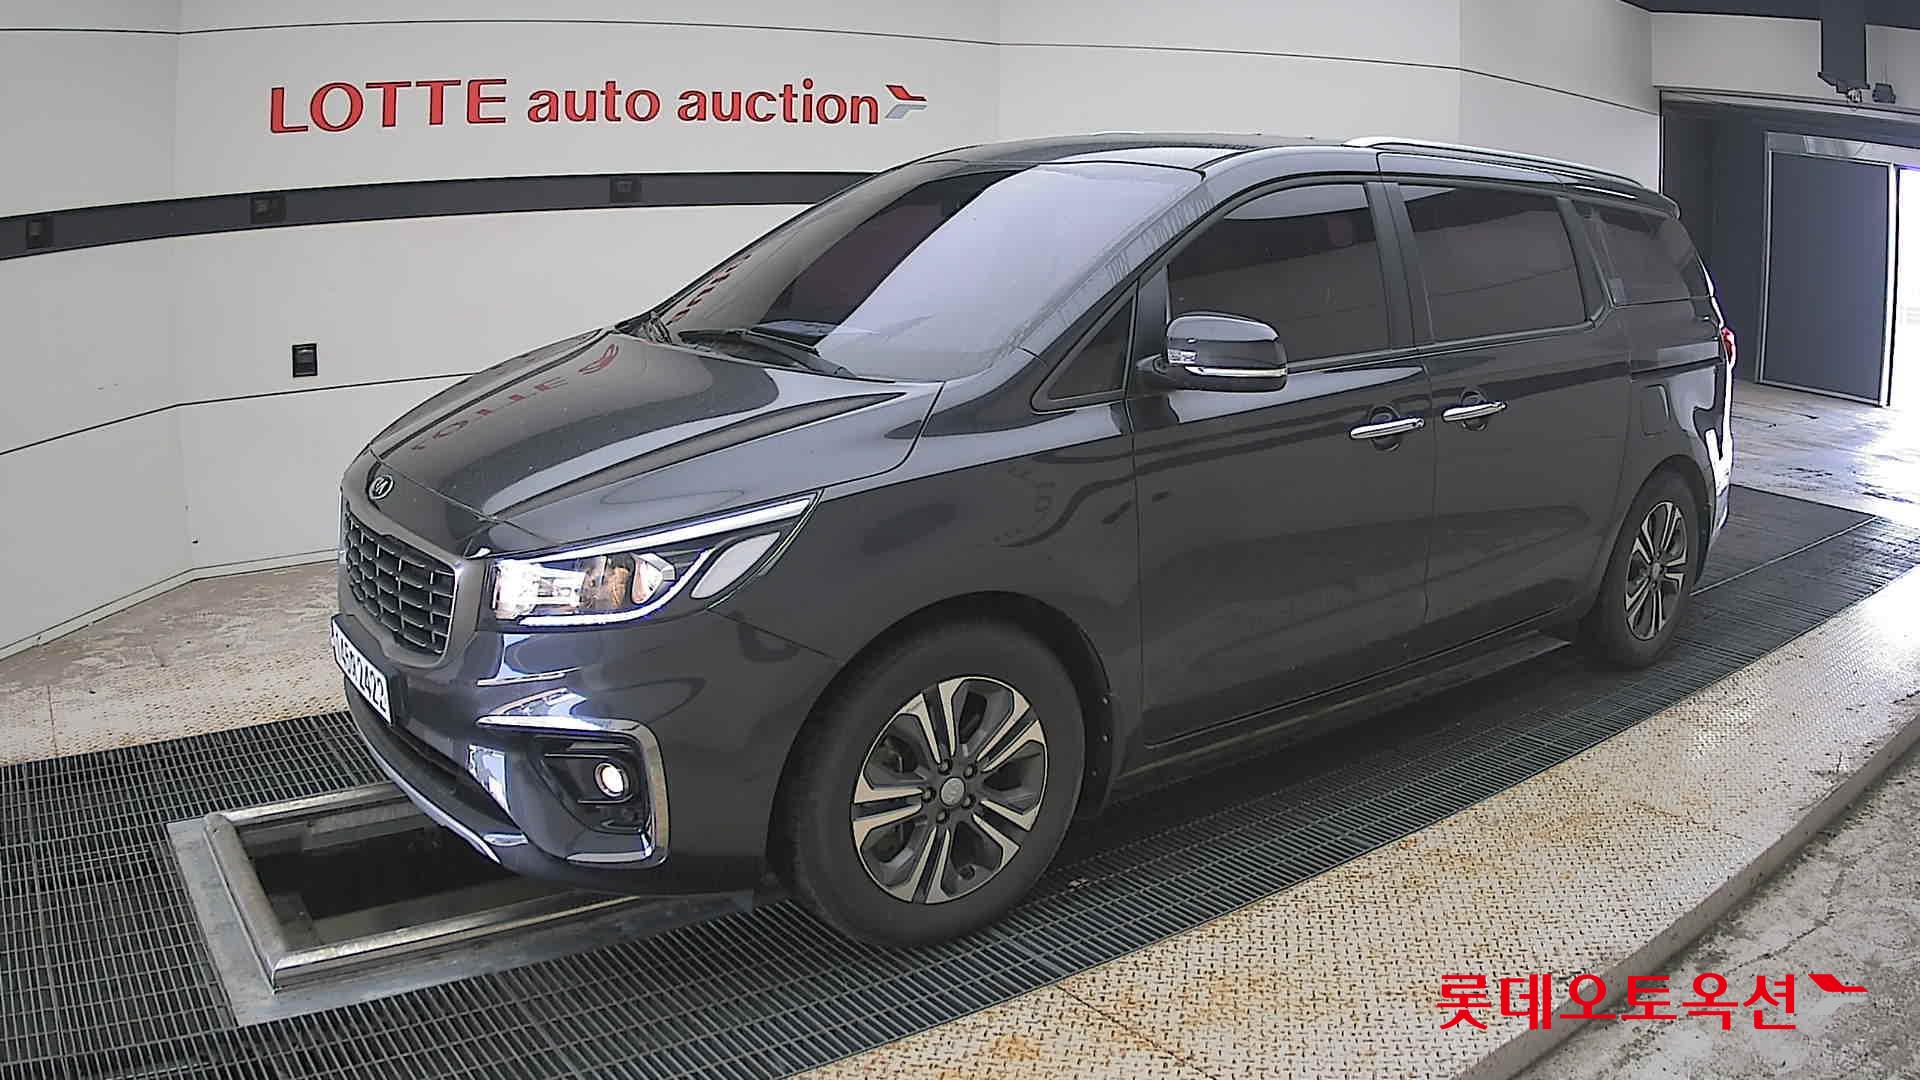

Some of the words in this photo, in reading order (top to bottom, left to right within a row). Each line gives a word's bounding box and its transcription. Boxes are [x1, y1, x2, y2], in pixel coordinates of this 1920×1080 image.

[269, 78, 506, 134] LOTTE
[527, 80, 662, 123] auto
[676, 78, 880, 125] auction
